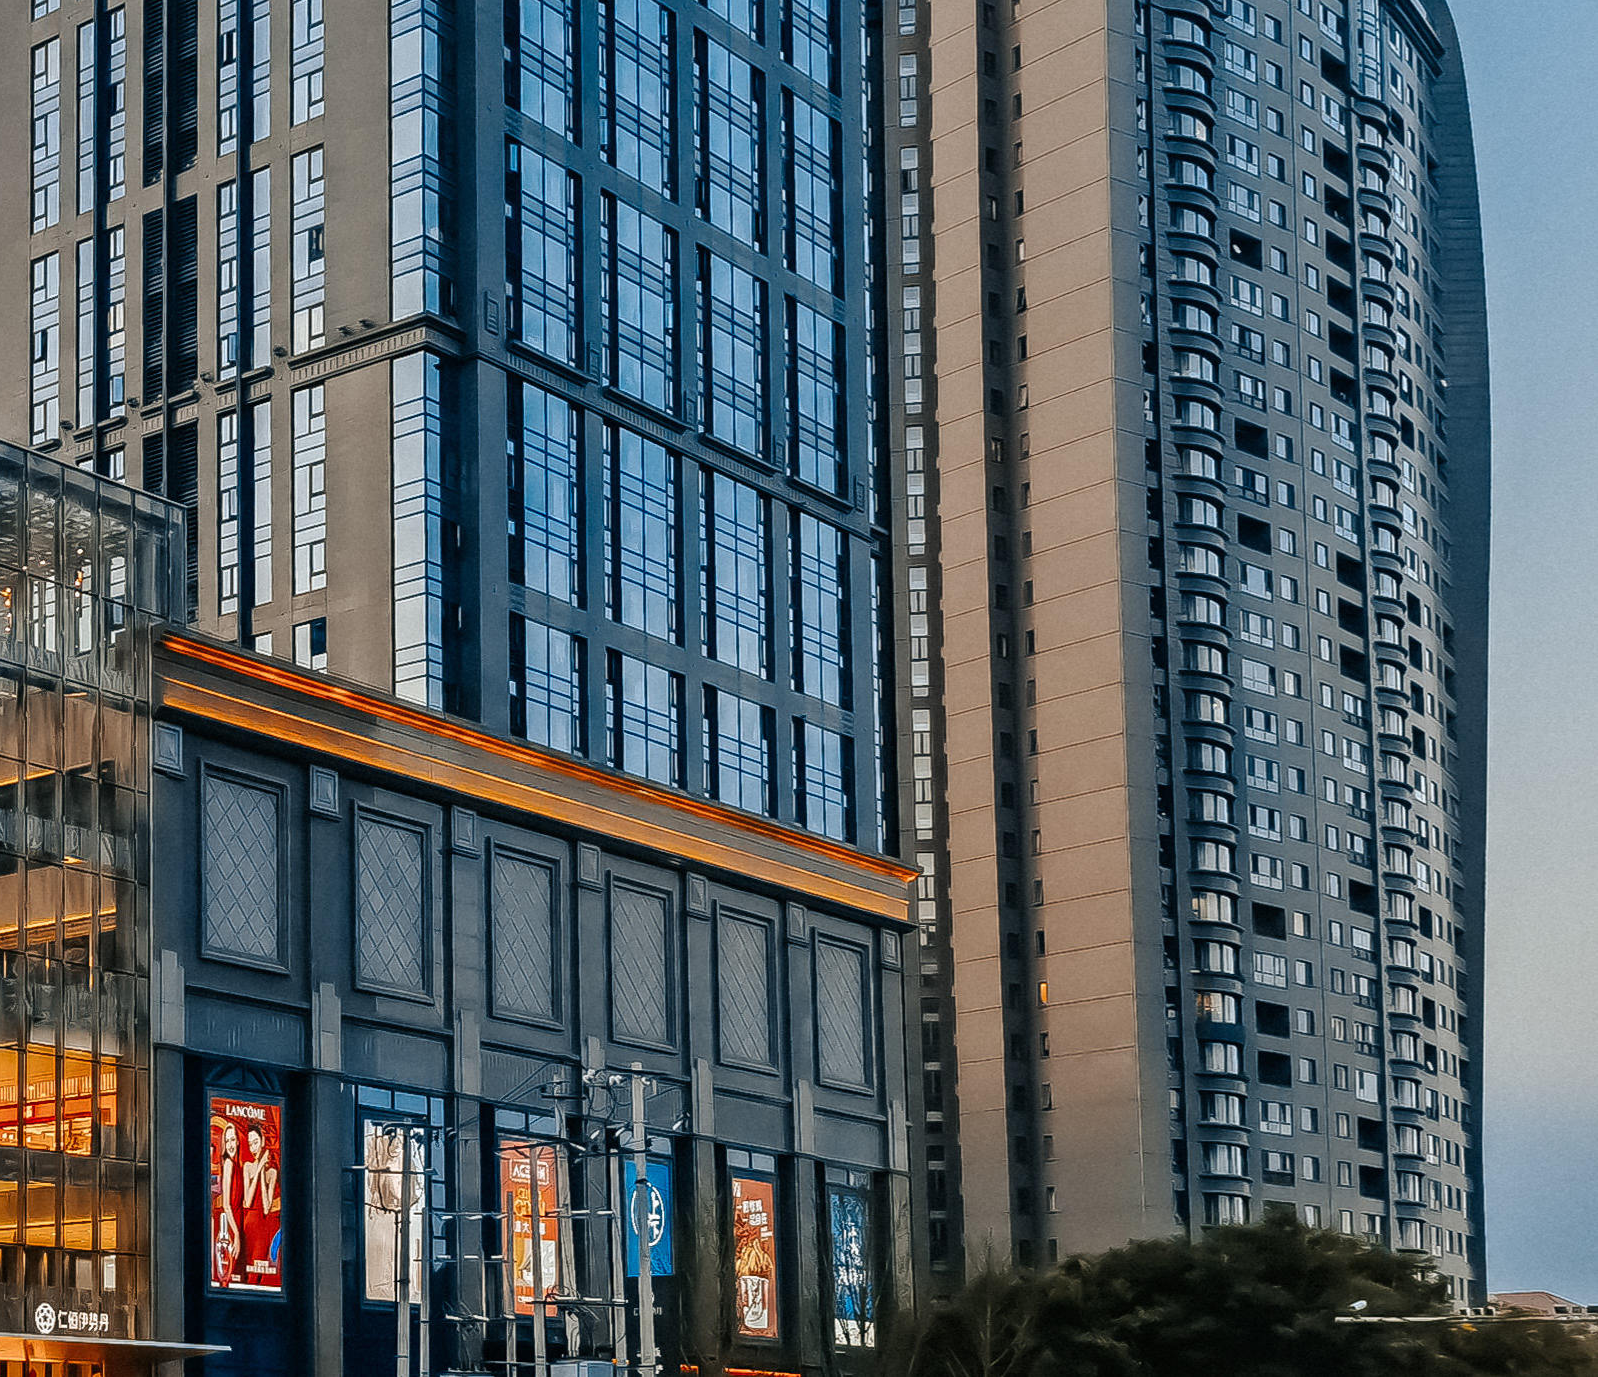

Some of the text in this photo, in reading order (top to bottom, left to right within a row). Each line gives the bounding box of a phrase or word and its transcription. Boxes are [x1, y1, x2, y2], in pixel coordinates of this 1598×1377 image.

[225, 1104, 267, 1121] LANCÔME
[58, 1309, 109, 1332] 仁恒伊势丹
